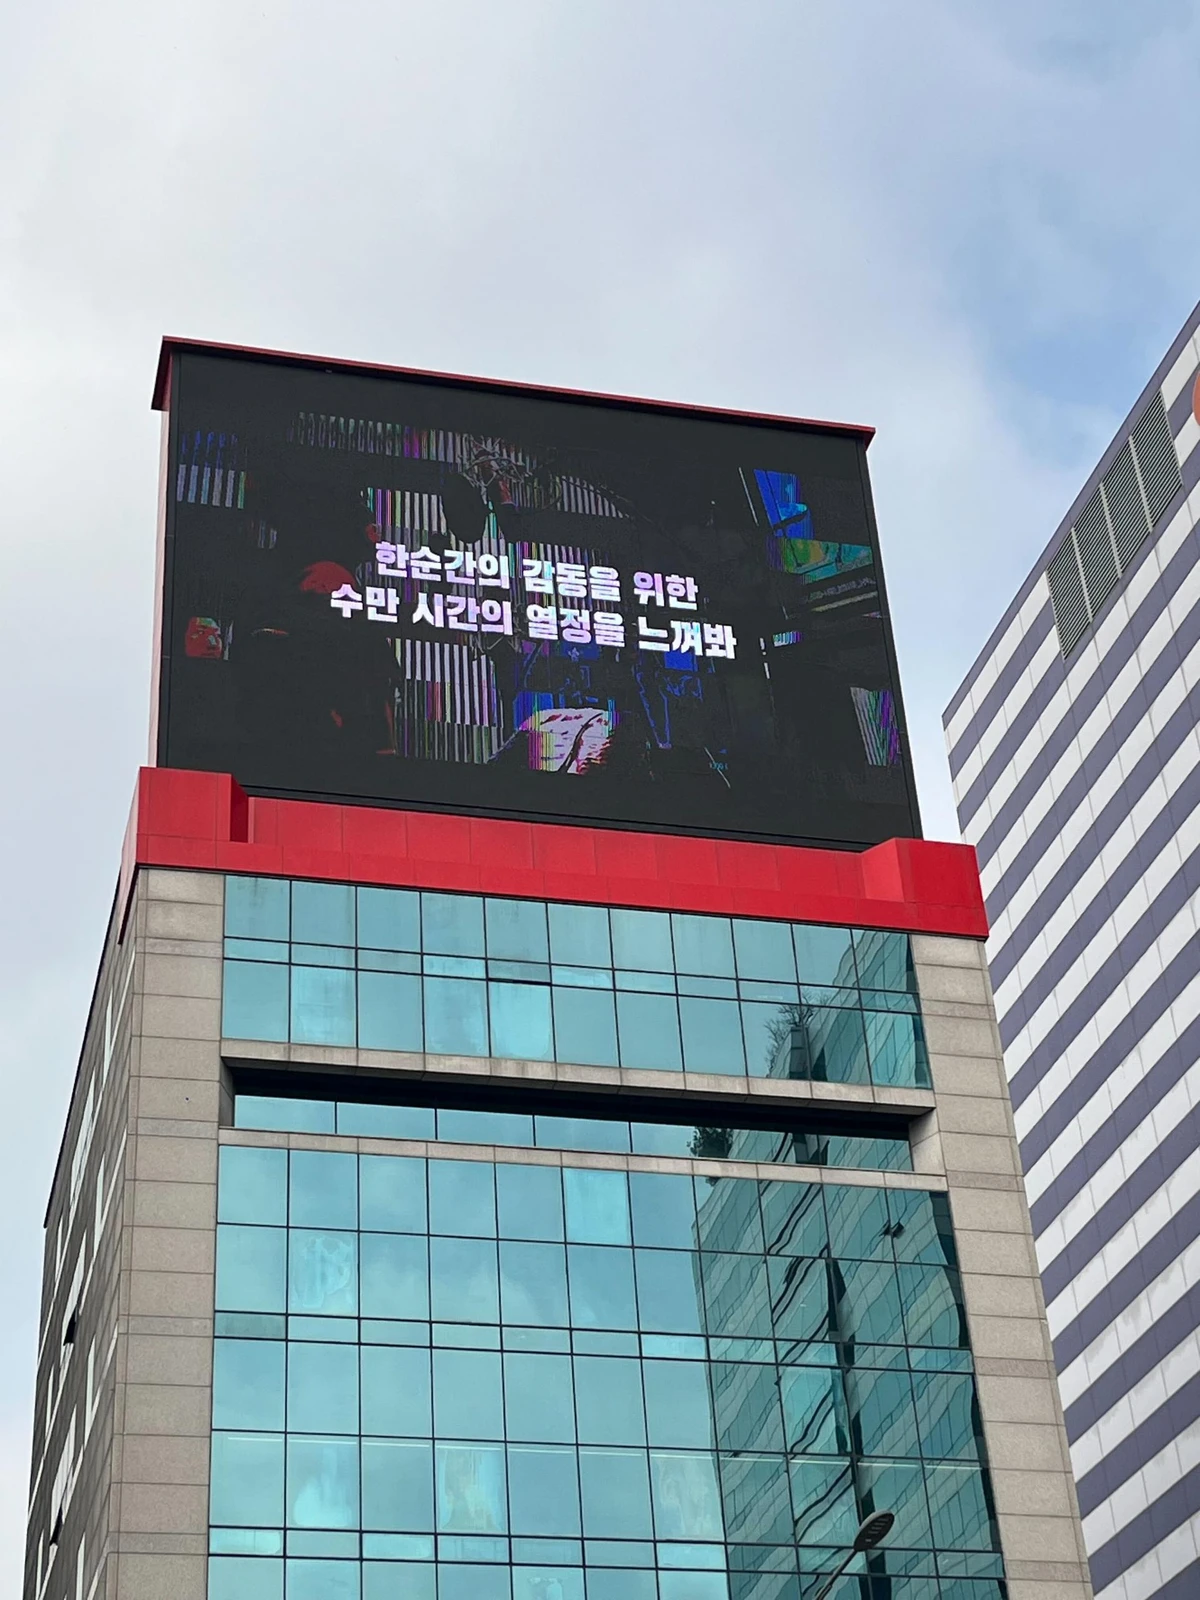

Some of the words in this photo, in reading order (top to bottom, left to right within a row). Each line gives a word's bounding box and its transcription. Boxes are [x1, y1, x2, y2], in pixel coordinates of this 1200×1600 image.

[375, 541, 510, 589] 한순간의
[522, 558, 621, 602] 감동을
[633, 571, 698, 610] 위한
[330, 583, 399, 623] 수만
[412, 591, 514, 636] 시간의
[526, 604, 626, 648] 열정을
[638, 617, 737, 660] 느껴봐
